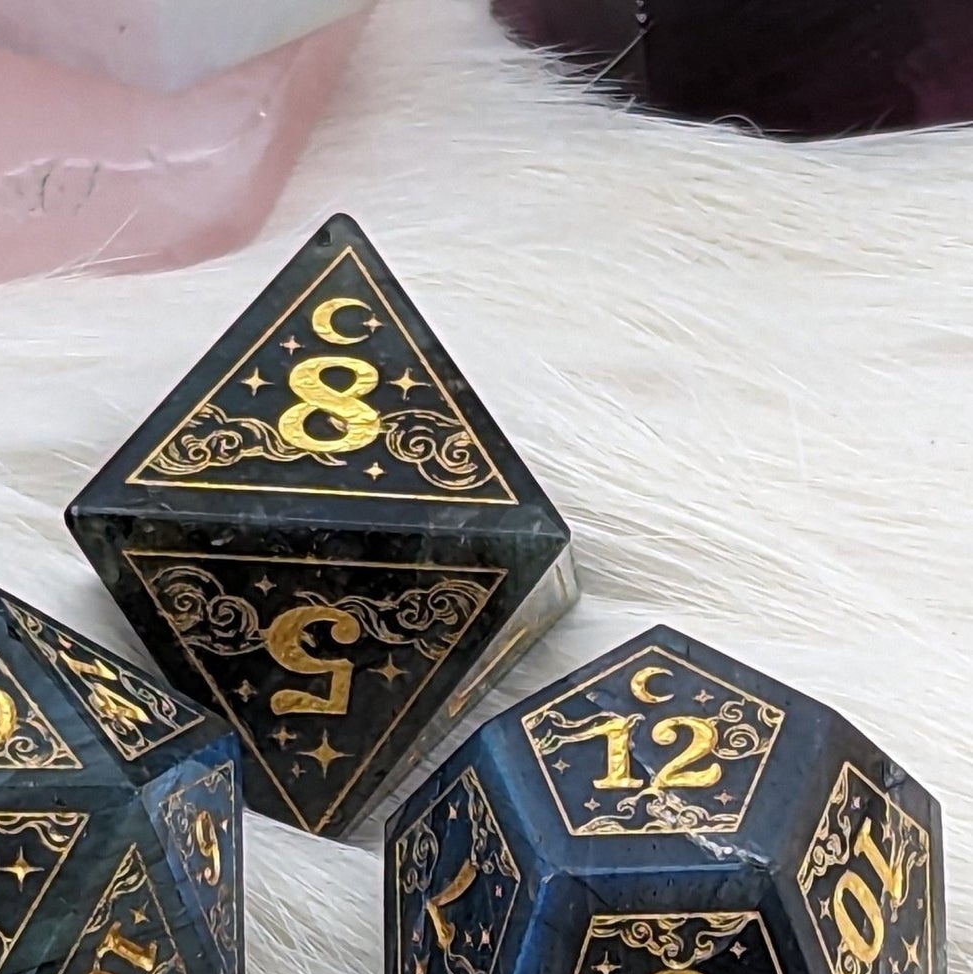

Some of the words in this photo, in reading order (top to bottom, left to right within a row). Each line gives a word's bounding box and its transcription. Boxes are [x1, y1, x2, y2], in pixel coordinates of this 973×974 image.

[278, 356, 383, 453] 8
[267, 605, 362, 716] 5
[590, 715, 723, 789] 12
[833, 816, 904, 965] 10
